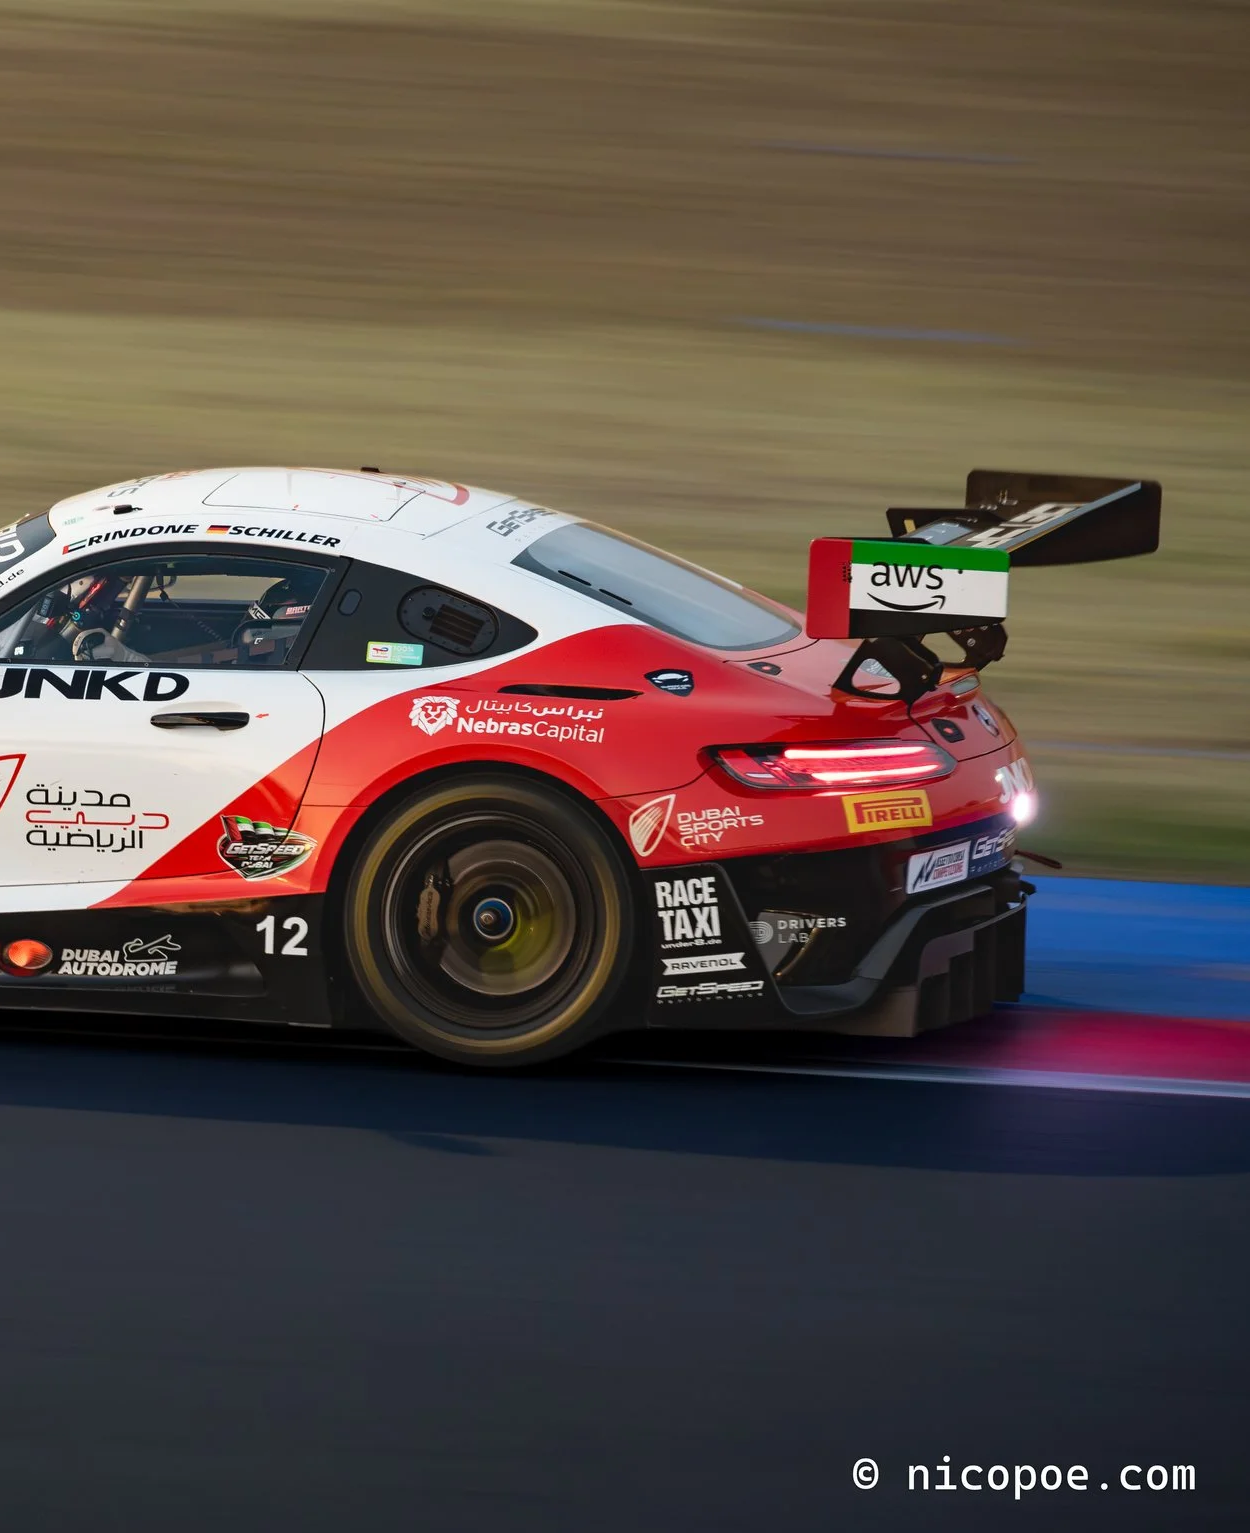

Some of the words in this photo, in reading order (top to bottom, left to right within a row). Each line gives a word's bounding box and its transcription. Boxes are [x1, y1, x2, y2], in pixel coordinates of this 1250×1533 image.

[87, 524, 199, 546] RINDONE
[229, 525, 341, 548] SCHILLER
[871, 561, 944, 590] aws
[26, 784, 131, 811] مدينة
[25, 810, 170, 830] دبي
[677, 806, 741, 824] DUBAI
[853, 797, 925, 825] PIRELLI
[678, 815, 765, 836] SPORTS
[26, 825, 143, 853] الرياضية
[680, 831, 724, 847] CITY
[654, 876, 718, 908] RACE
[658, 906, 721, 941] TAXI
[778, 917, 847, 930] DRIVERS
[256, 915, 309, 956] 12
[661, 938, 722, 950] under8.de
[778, 932, 810, 944] LAB
[61, 949, 119, 963] DUBAI
[671, 958, 737, 971] RAVENOL
[58, 961, 178, 976] AUTODROME
